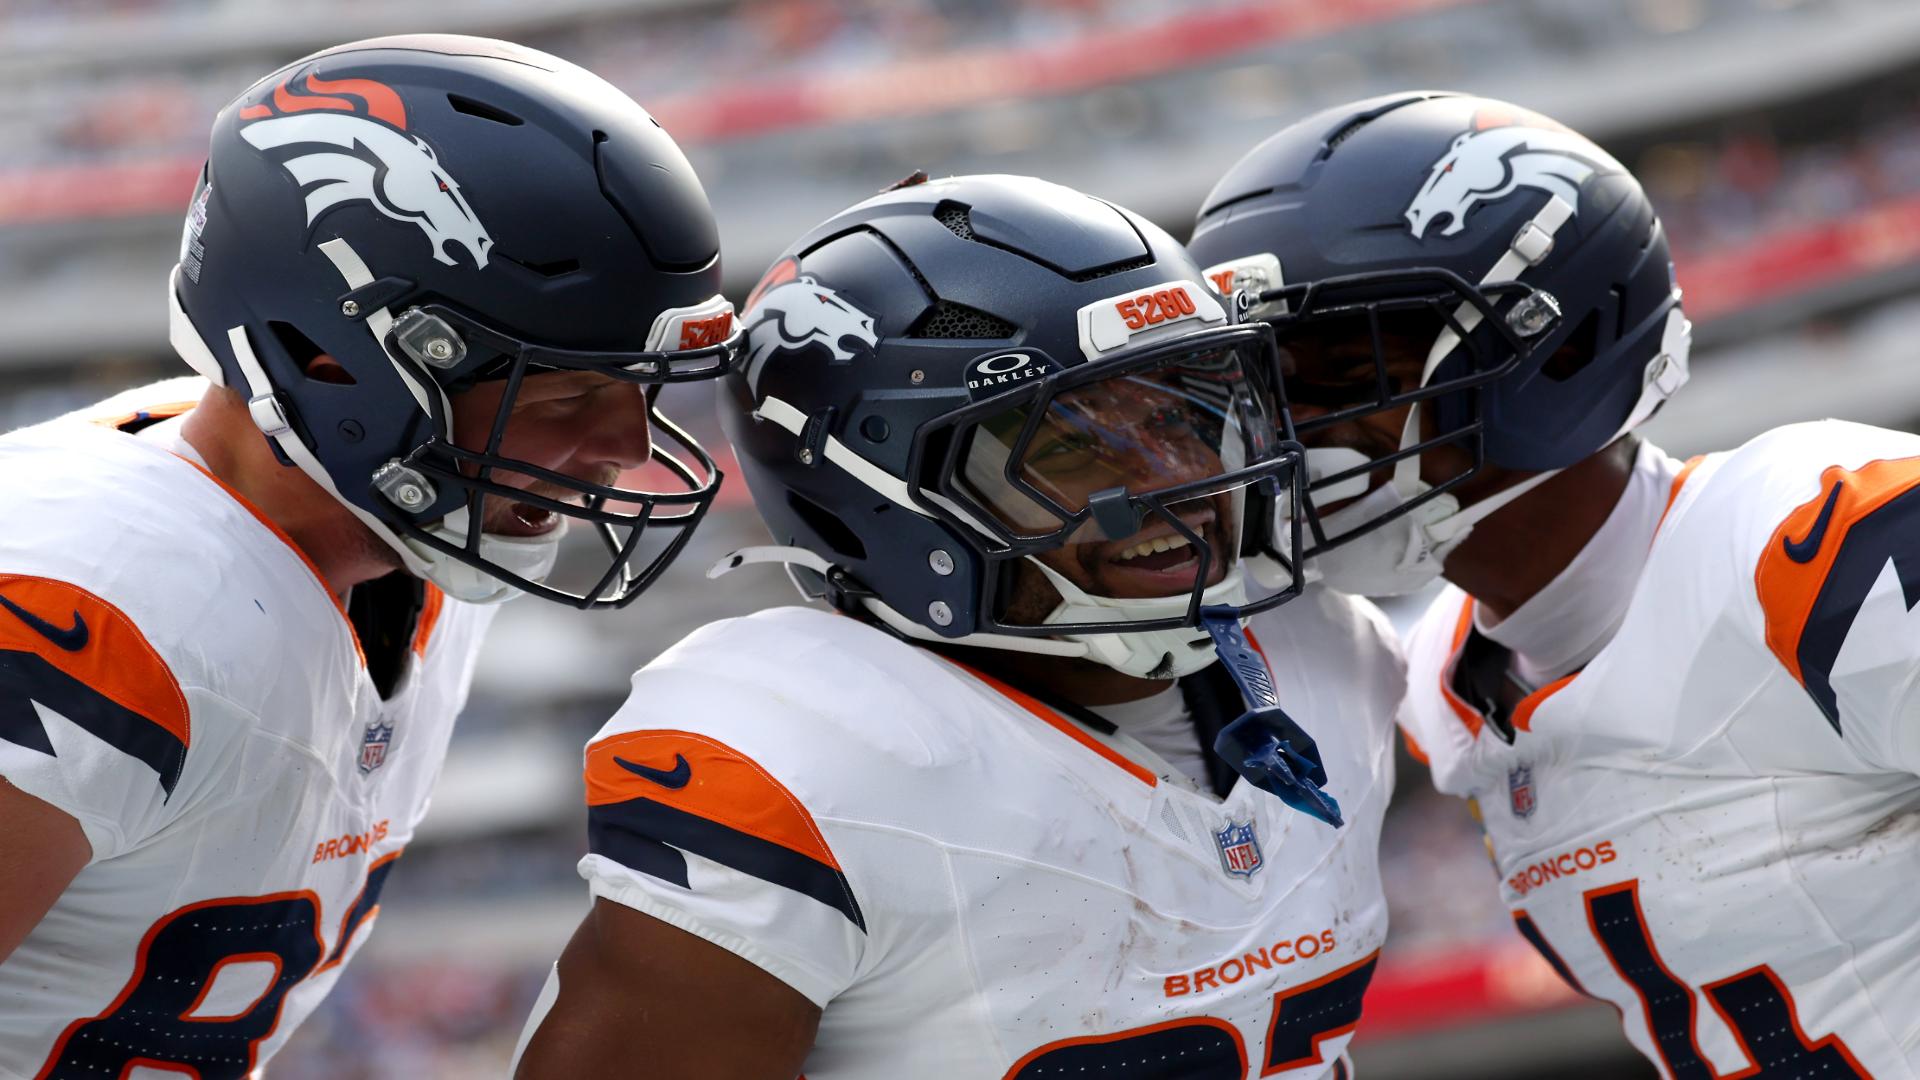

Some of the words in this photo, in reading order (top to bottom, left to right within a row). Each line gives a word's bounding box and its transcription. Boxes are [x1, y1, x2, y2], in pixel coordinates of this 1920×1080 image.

[1115, 287, 1196, 330] 5280
[968, 366, 1047, 389] OAKLEY
[361, 745, 385, 767] NFL
[312, 819, 389, 864] BRONS
[1226, 844, 1259, 870] NFL
[1508, 840, 1617, 896] BRONCOS
[1164, 928, 1336, 998] BRONCOS
